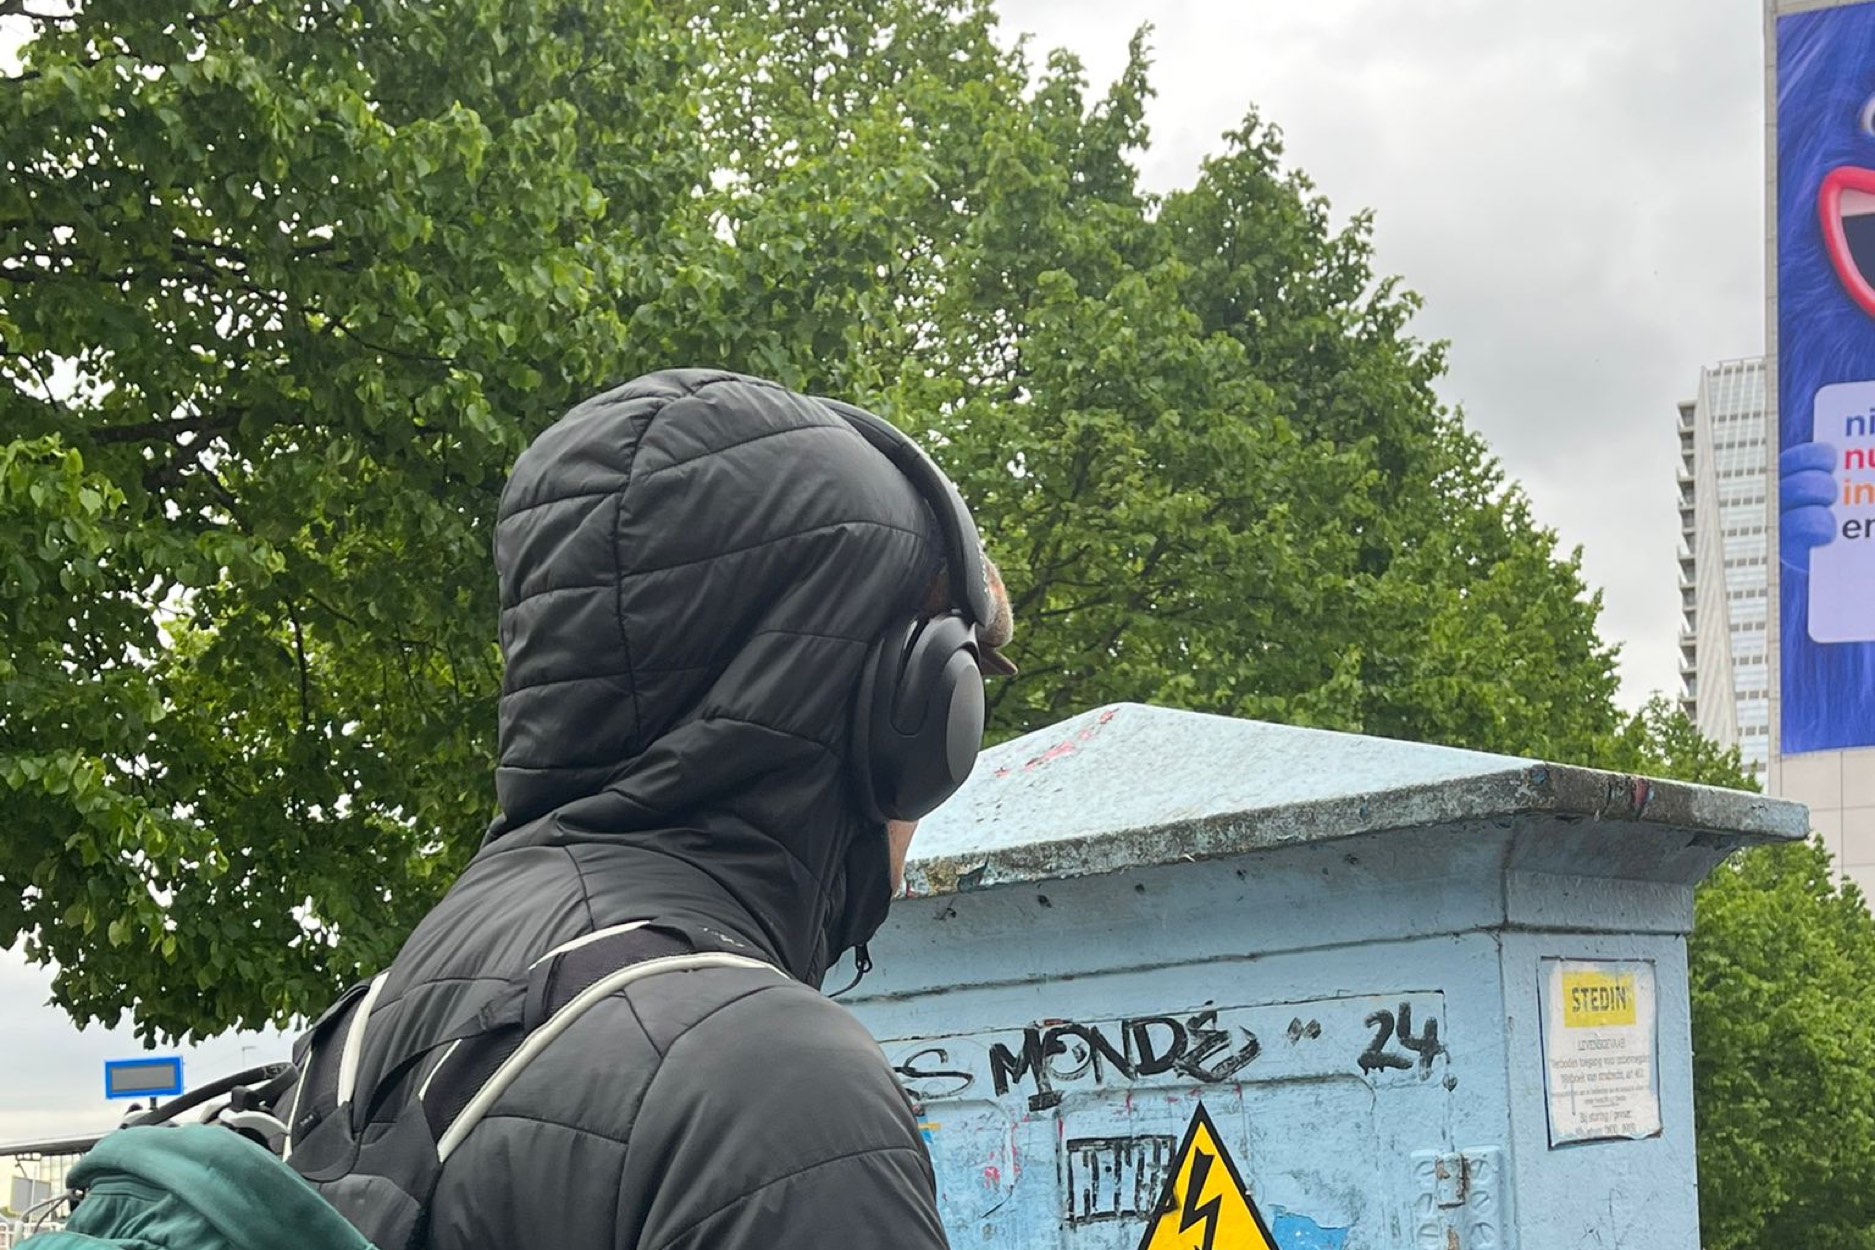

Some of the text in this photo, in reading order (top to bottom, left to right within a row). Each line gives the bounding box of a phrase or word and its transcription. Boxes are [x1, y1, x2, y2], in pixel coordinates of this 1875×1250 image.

[1572, 986, 1627, 1013] STEDIN
[989, 1010, 1261, 1112] MONDE
[1357, 1001, 1449, 1081] 24
